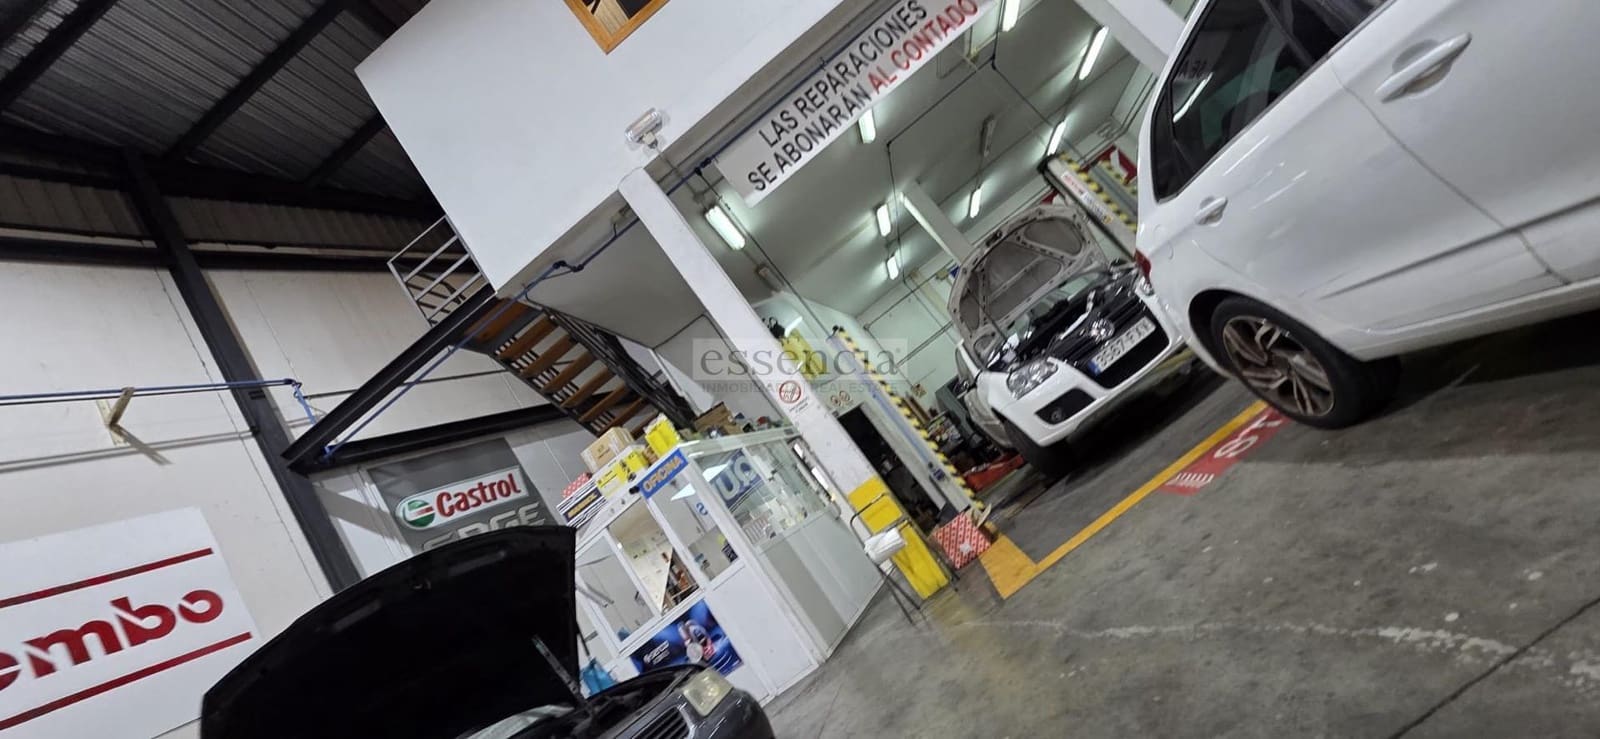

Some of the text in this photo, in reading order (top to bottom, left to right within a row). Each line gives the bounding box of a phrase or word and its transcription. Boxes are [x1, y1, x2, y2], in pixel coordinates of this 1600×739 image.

[747, 0, 979, 192] SE ABONARÁN AL CONTADO
[758, 0, 928, 148] LAS REPARACIONES
[436, 472, 522, 517] Castrol
[642, 456, 685, 492] OFICINA
